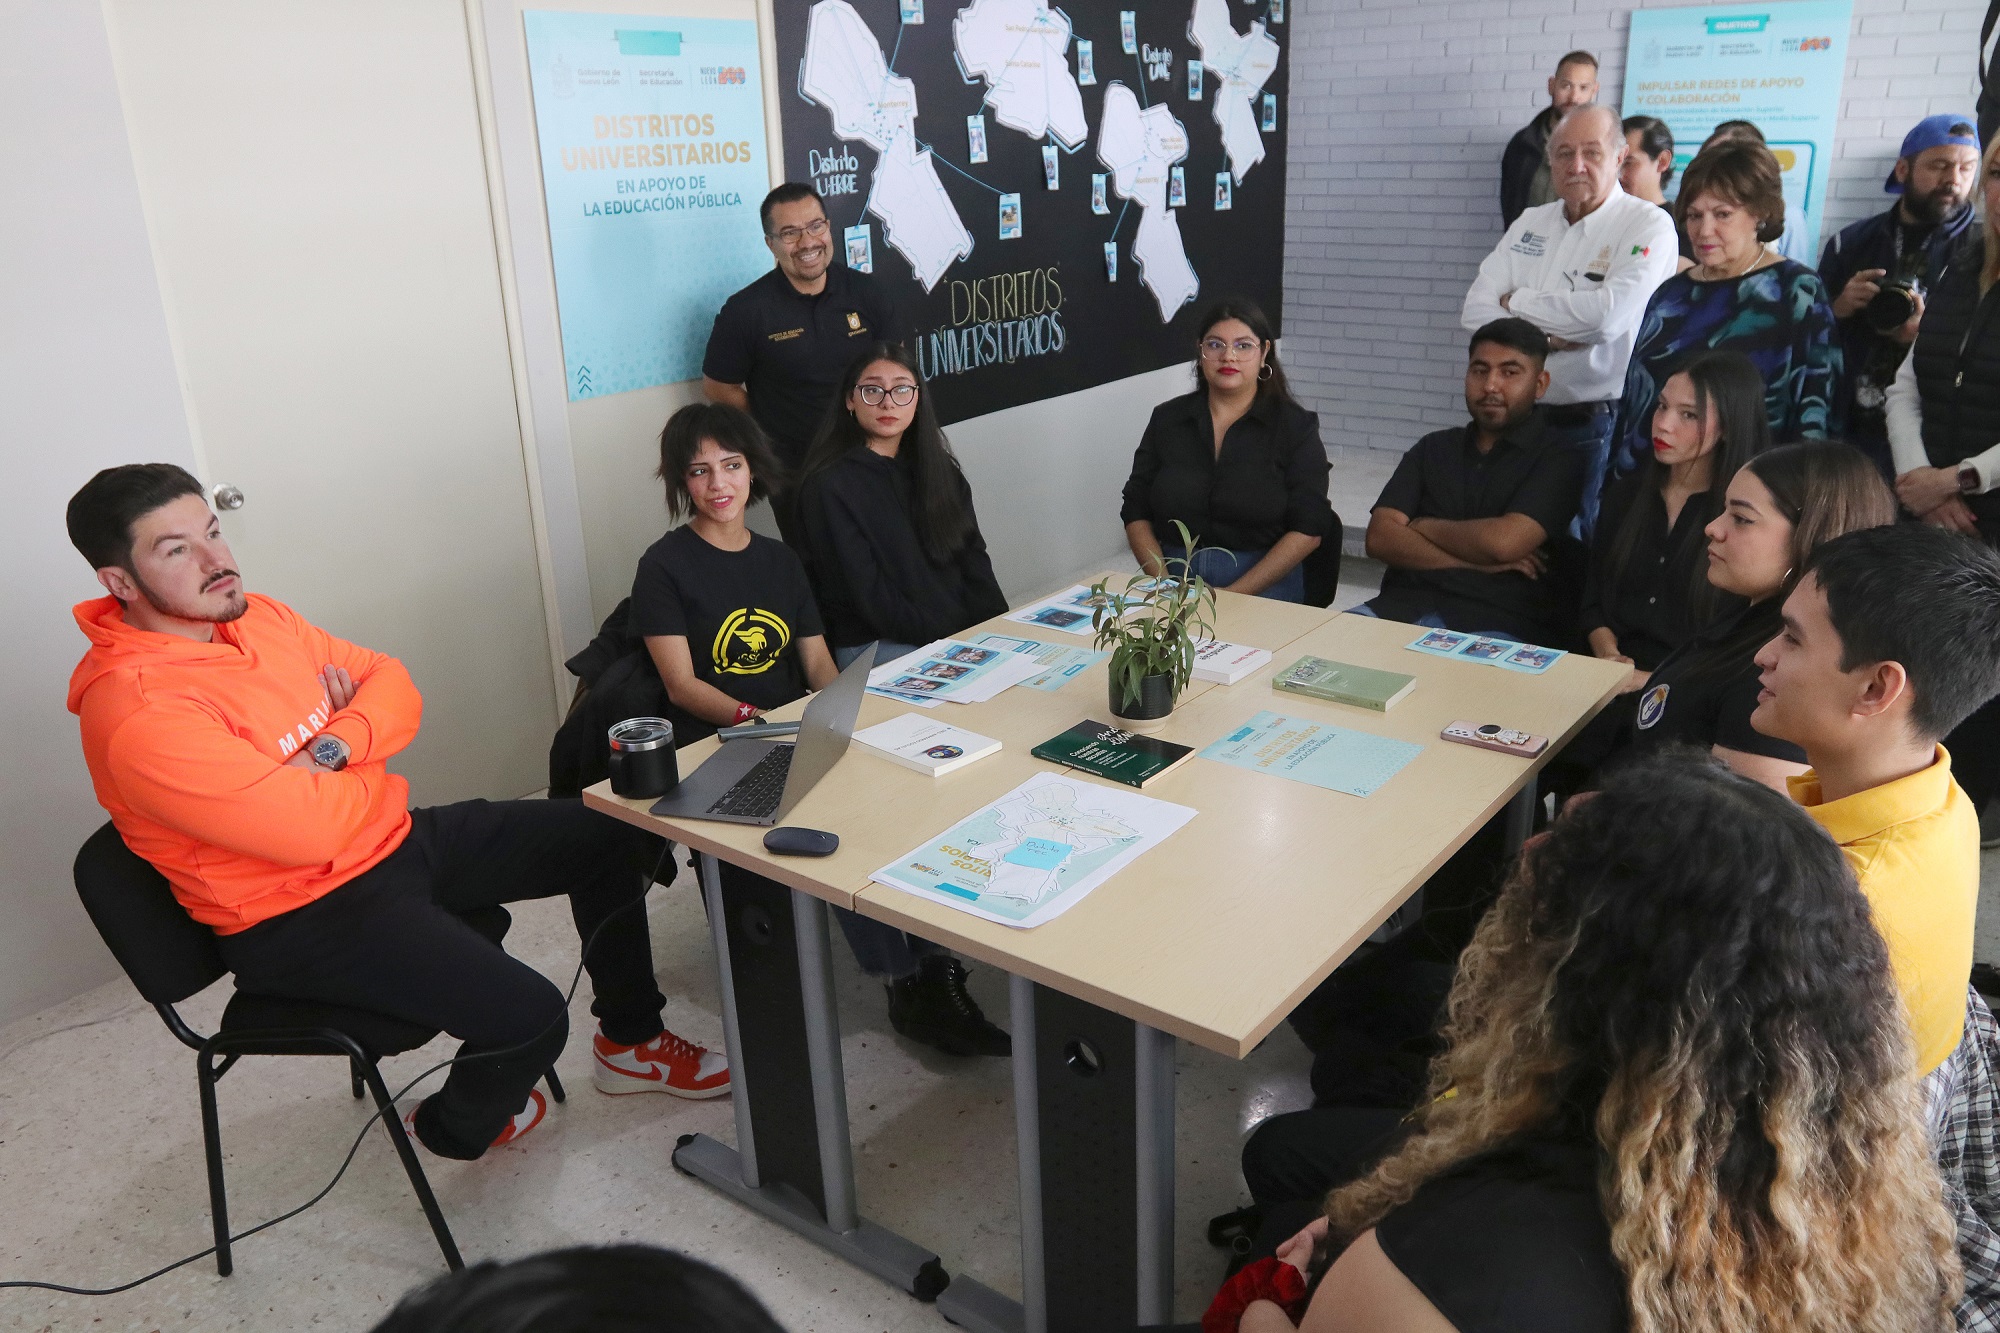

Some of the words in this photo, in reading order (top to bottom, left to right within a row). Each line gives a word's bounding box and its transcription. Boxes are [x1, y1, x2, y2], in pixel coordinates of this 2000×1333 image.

[1637, 79, 1697, 92] IMPULSAR
[1700, 78, 1738, 90] REDES
[1741, 78, 1757, 89] DE
[1760, 77, 1805, 88] APOYO
[1637, 94, 1644, 104] Y
[1646, 92, 1740, 105] COLABORACIÓN
[593, 113, 715, 139] DISTRITOS
[560, 141, 751, 172] UNIVERSITARIOS
[809, 144, 859, 178] Distrito
[616, 180, 635, 194] EN
[638, 177, 686, 193] APOYO
[689, 176, 706, 189] DE
[583, 202, 601, 217] LA
[605, 194, 685, 215] EDUCACIÓN
[689, 192, 742, 208] PÚBLICA
[951, 266, 1062, 326] DISTRITOS
[918, 310, 1064, 382] UNIVERSITARIOS
[278, 692, 330, 756] MARI
[950, 859, 991, 878] RITOS
